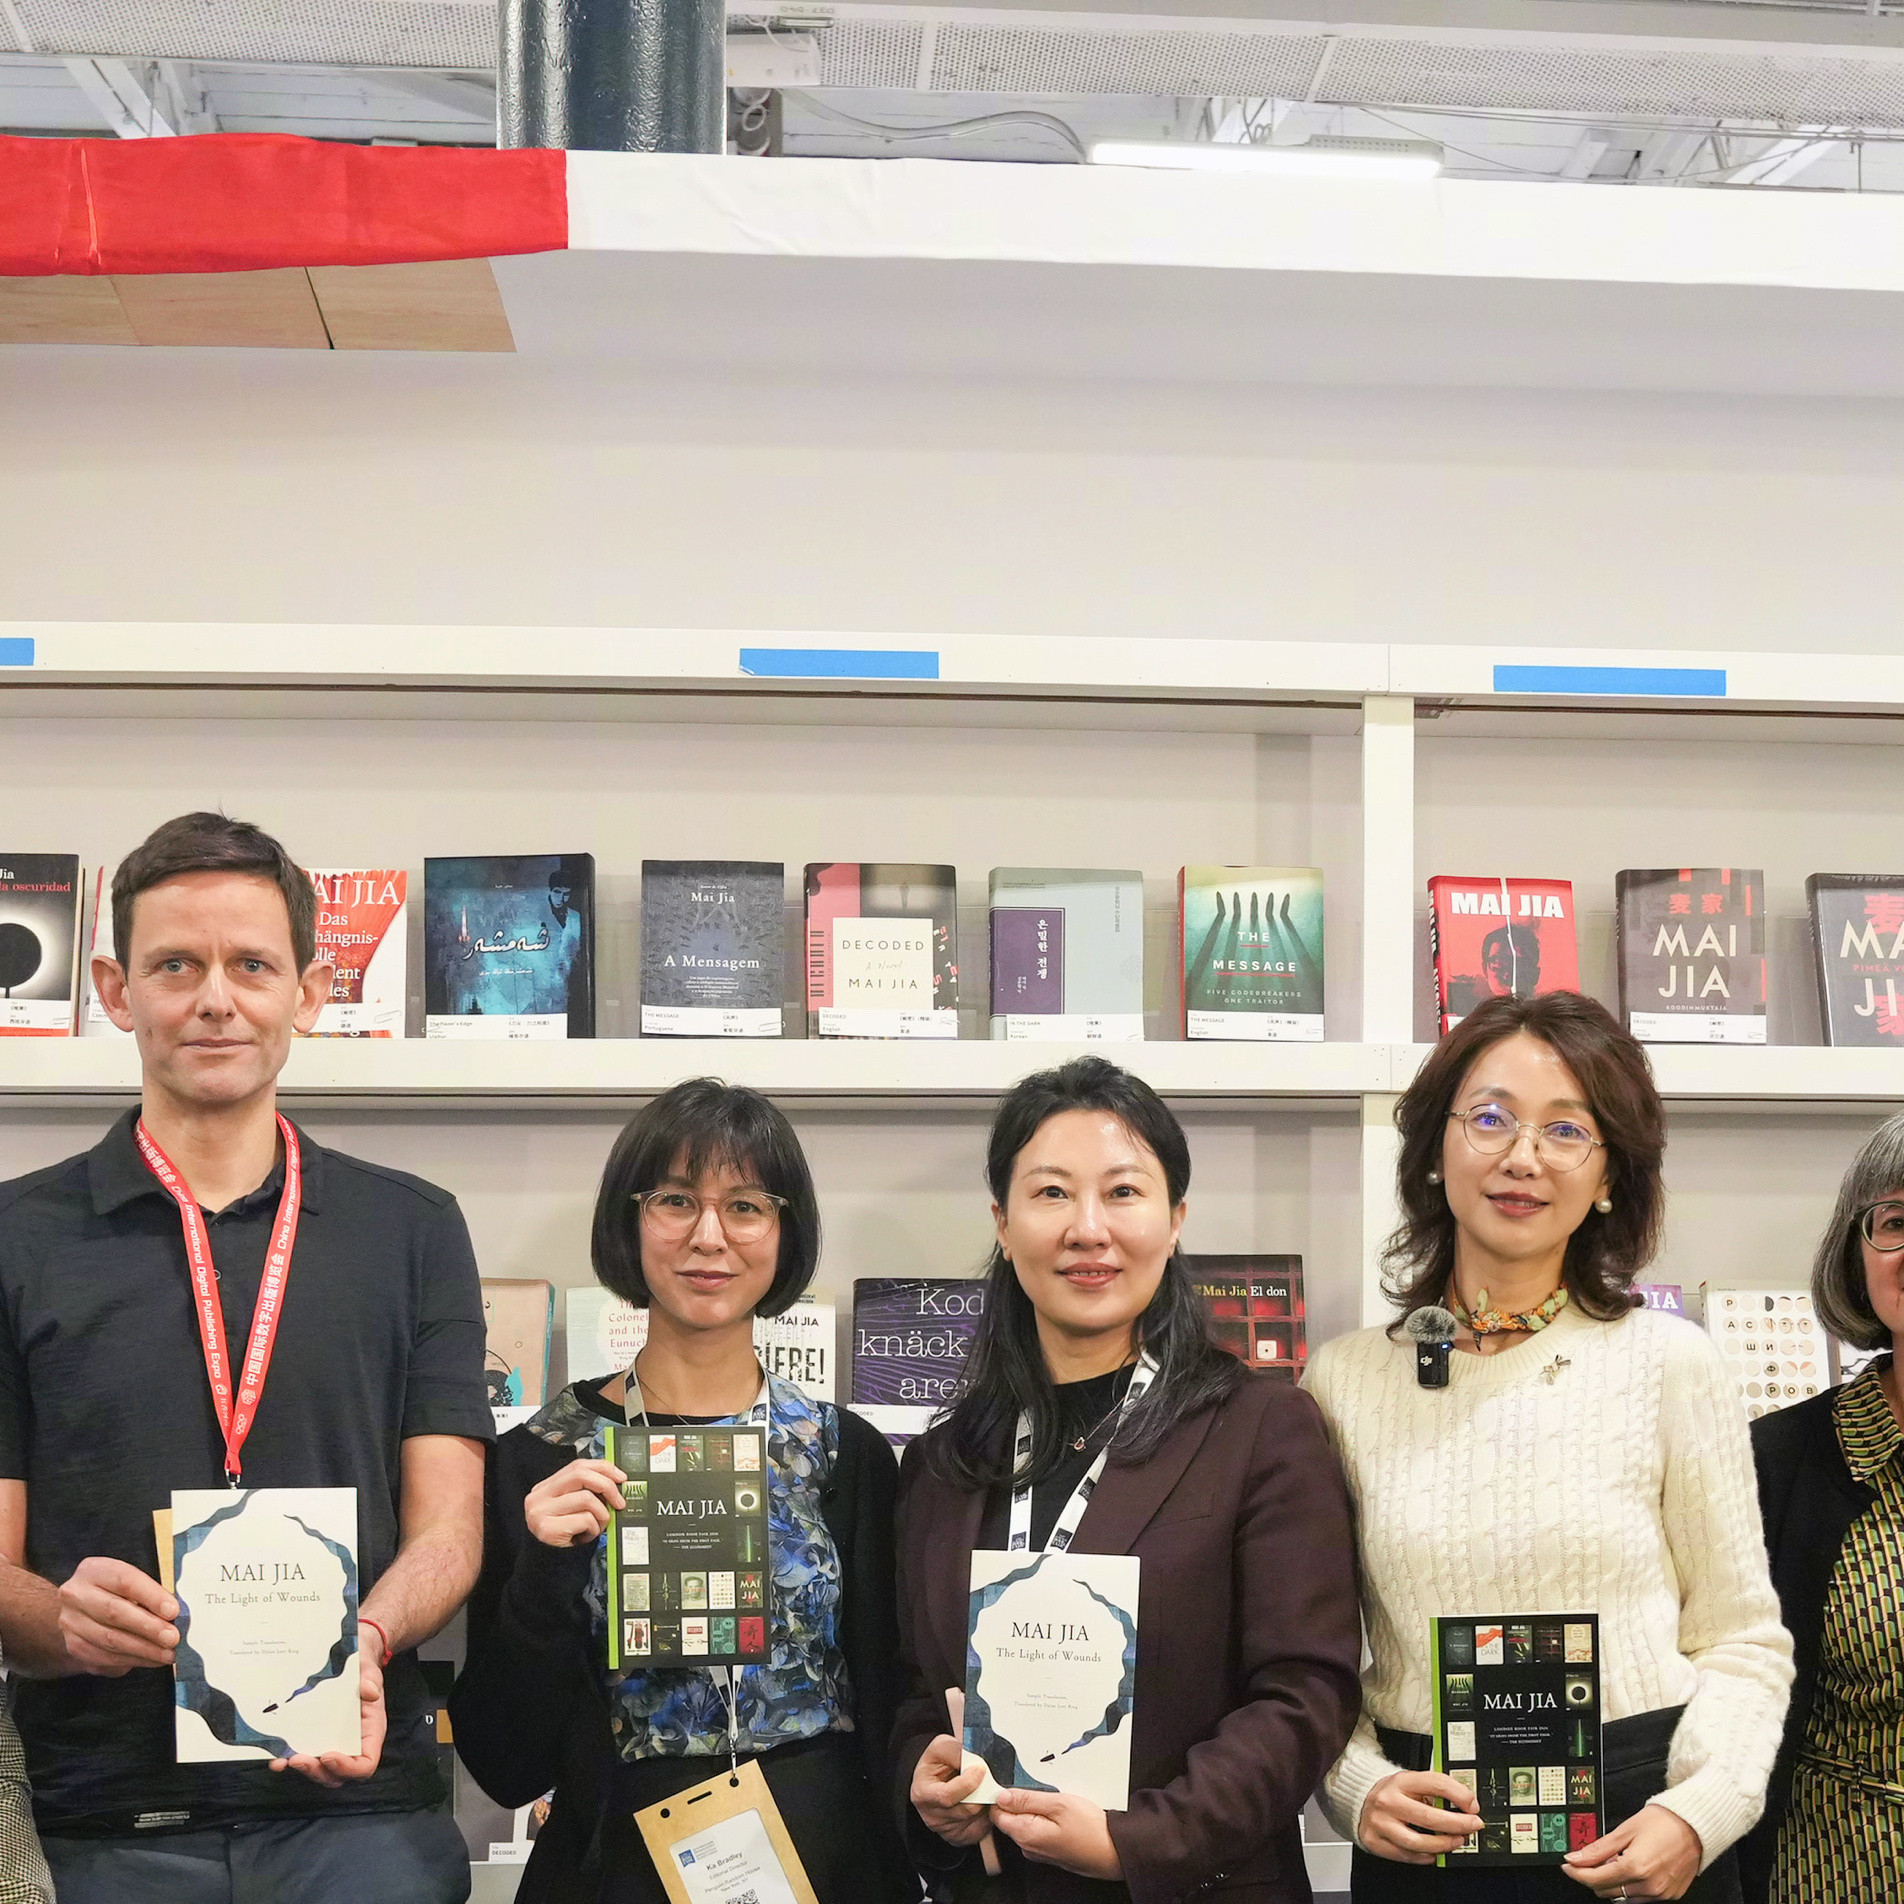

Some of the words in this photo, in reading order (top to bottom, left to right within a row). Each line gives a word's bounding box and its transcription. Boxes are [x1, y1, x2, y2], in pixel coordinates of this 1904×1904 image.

[12, 881, 71, 892] oscuridad
[314, 880, 343, 904] AI
[351, 880, 401, 907] JIA
[691, 892, 714, 902] Mai
[718, 892, 735, 904] Jia
[1451, 892, 1511, 915] MAI
[1518, 894, 1565, 918] JIA
[319, 912, 348, 926] Das
[314, 931, 378, 947] hängnis-
[842, 939, 924, 950] DECODED
[1238, 932, 1270, 942] THE
[1652, 923, 1737, 957] MAI
[664, 955, 676, 967] A
[682, 955, 760, 970] Mensagem
[1213, 960, 1296, 972] MESSAGE
[332, 965, 360, 979] lent
[848, 978, 882, 989] MAI
[892, 979, 918, 989] JIA
[1658, 965, 1731, 998] JIA
[1231, 989, 1302, 997] CODEBREAKERS
[282, 1166, 298, 1225] International
[184, 1203, 205, 1265] International
[277, 1223, 291, 1250] China
[196, 1266, 211, 1297] Digital
[1203, 1285, 1227, 1297] Mai
[1229, 1285, 1247, 1297] Jia
[1250, 1285, 1263, 1297] El
[1266, 1285, 1288, 1297] don
[202, 1299, 218, 1351] Publishing
[245, 1252, 285, 1387] 中国国际数字出版博览会
[774, 1316, 798, 1326] MAI
[801, 1317, 819, 1326] JIA
[608, 1326, 627, 1335] and
[210, 1352, 223, 1380] Expo
[613, 1363, 630, 1371] Ma
[656, 1500, 695, 1516] MAI
[699, 1499, 728, 1519] JIA
[220, 1563, 265, 1582] MAI
[272, 1563, 306, 1586] JIA
[205, 1593, 227, 1604] The
[231, 1593, 259, 1607] Light
[262, 1592, 274, 1603] of
[277, 1591, 321, 1602] Wounds
[1011, 1621, 1053, 1639] MAI
[1058, 1624, 1089, 1645] JIA
[996, 1647, 1015, 1658] The
[1019, 1649, 1045, 1662] Light
[1048, 1650, 1061, 1660] of
[1062, 1651, 1102, 1662] Wounds
[1484, 1694, 1522, 1710] MAI
[1527, 1693, 1558, 1713] JIA
[705, 1862, 717, 1871] Ka
[716, 1851, 744, 1867] Bradley
